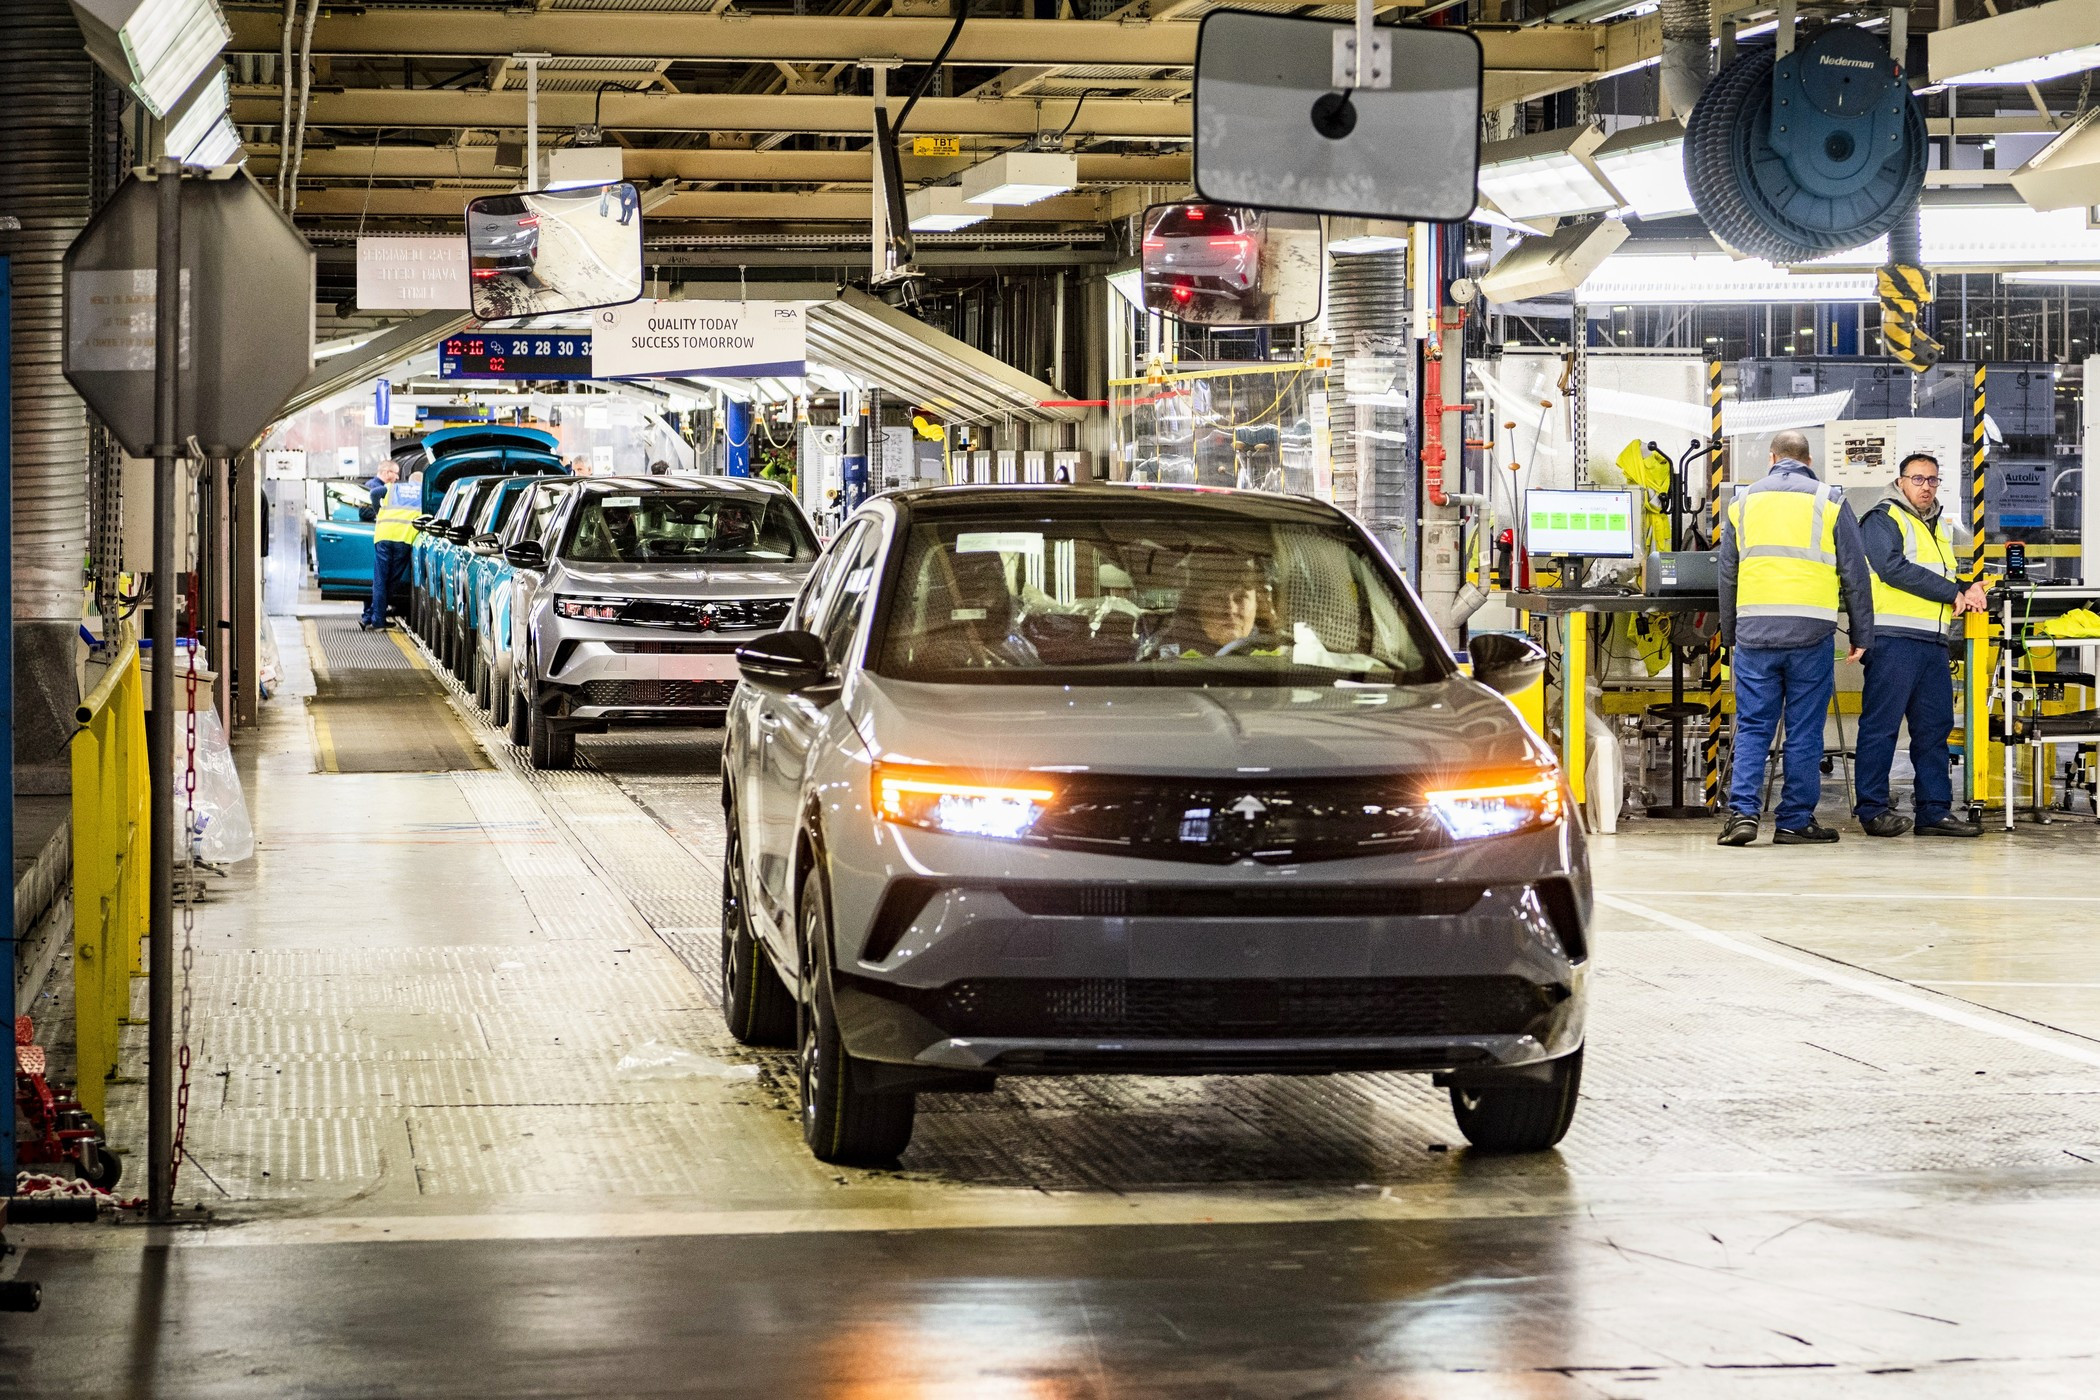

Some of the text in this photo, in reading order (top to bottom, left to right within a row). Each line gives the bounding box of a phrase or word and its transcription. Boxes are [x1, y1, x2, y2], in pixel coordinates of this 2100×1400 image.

[1820, 55, 1874, 69] Nederman
[933, 138, 953, 146] TBT
[603, 311, 614, 323] Q
[774, 309, 798, 318] PSA
[648, 318, 739, 333] QUALITY TODAY
[512, 341, 528, 355] 26
[535, 341, 551, 355] 28
[558, 341, 574, 355] 30
[631, 336, 755, 349] SUCCESS TOMORROW
[2005, 473, 2040, 482] Autoliv
